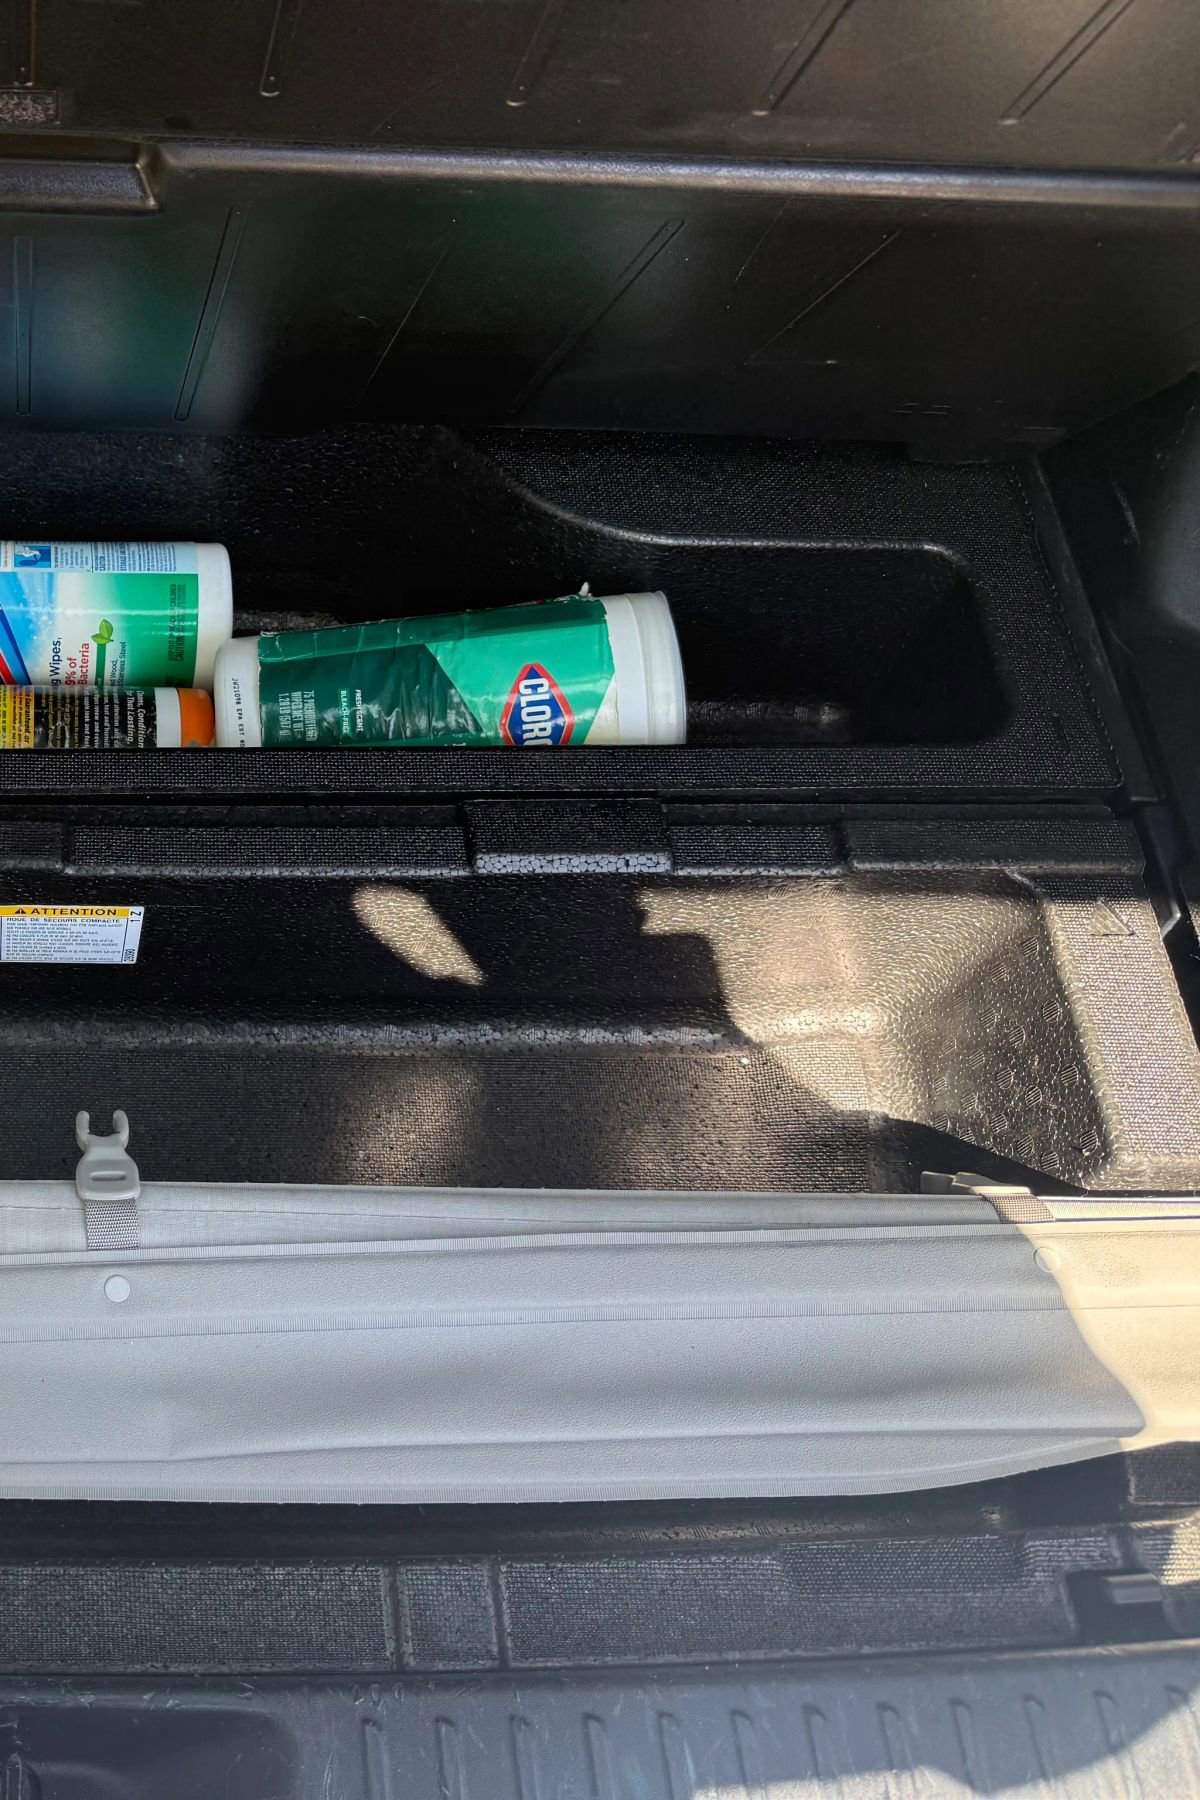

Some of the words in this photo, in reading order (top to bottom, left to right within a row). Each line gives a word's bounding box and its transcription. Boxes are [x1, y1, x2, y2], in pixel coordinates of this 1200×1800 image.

[118, 641, 127, 659] Steel
[67, 656, 77, 669] of
[77, 643, 90, 685] Bacteria
[354, 689, 362, 709] FRESH
[340, 690, 350, 735] BLEACH-FREE
[356, 710, 364, 732] SCENT
[30, 908, 117, 916] ATTENTION
